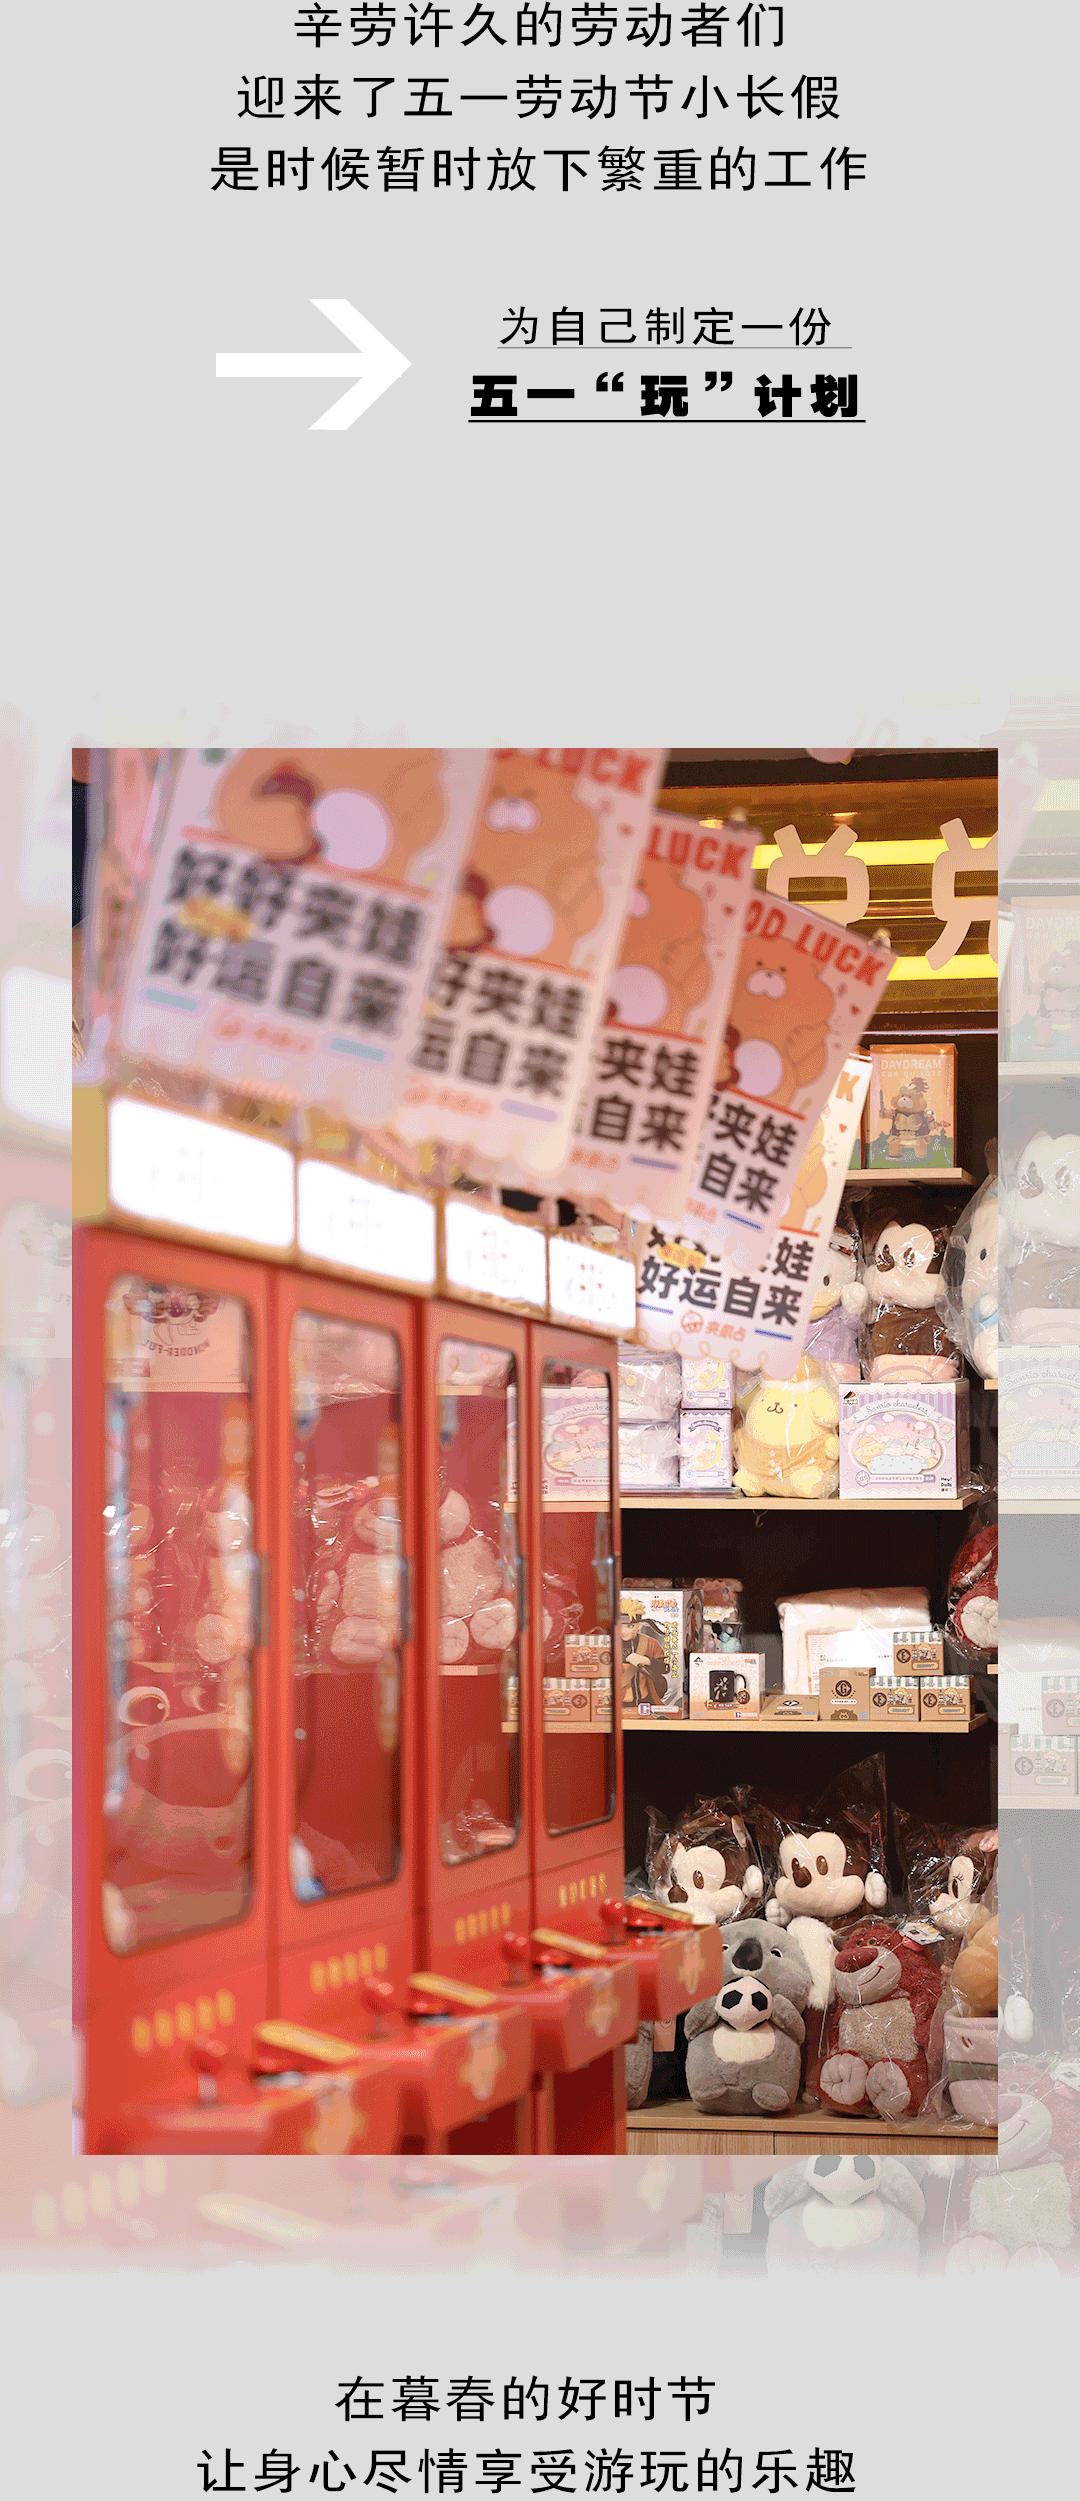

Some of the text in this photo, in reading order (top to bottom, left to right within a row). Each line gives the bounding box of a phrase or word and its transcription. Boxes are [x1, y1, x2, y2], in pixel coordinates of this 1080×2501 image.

[645, 825, 748, 880] LUCK
[795, 922, 886, 987] LUCK
[881, 1059, 942, 1071] DAYDREAM
[637, 1255, 803, 1327] 好运自来
